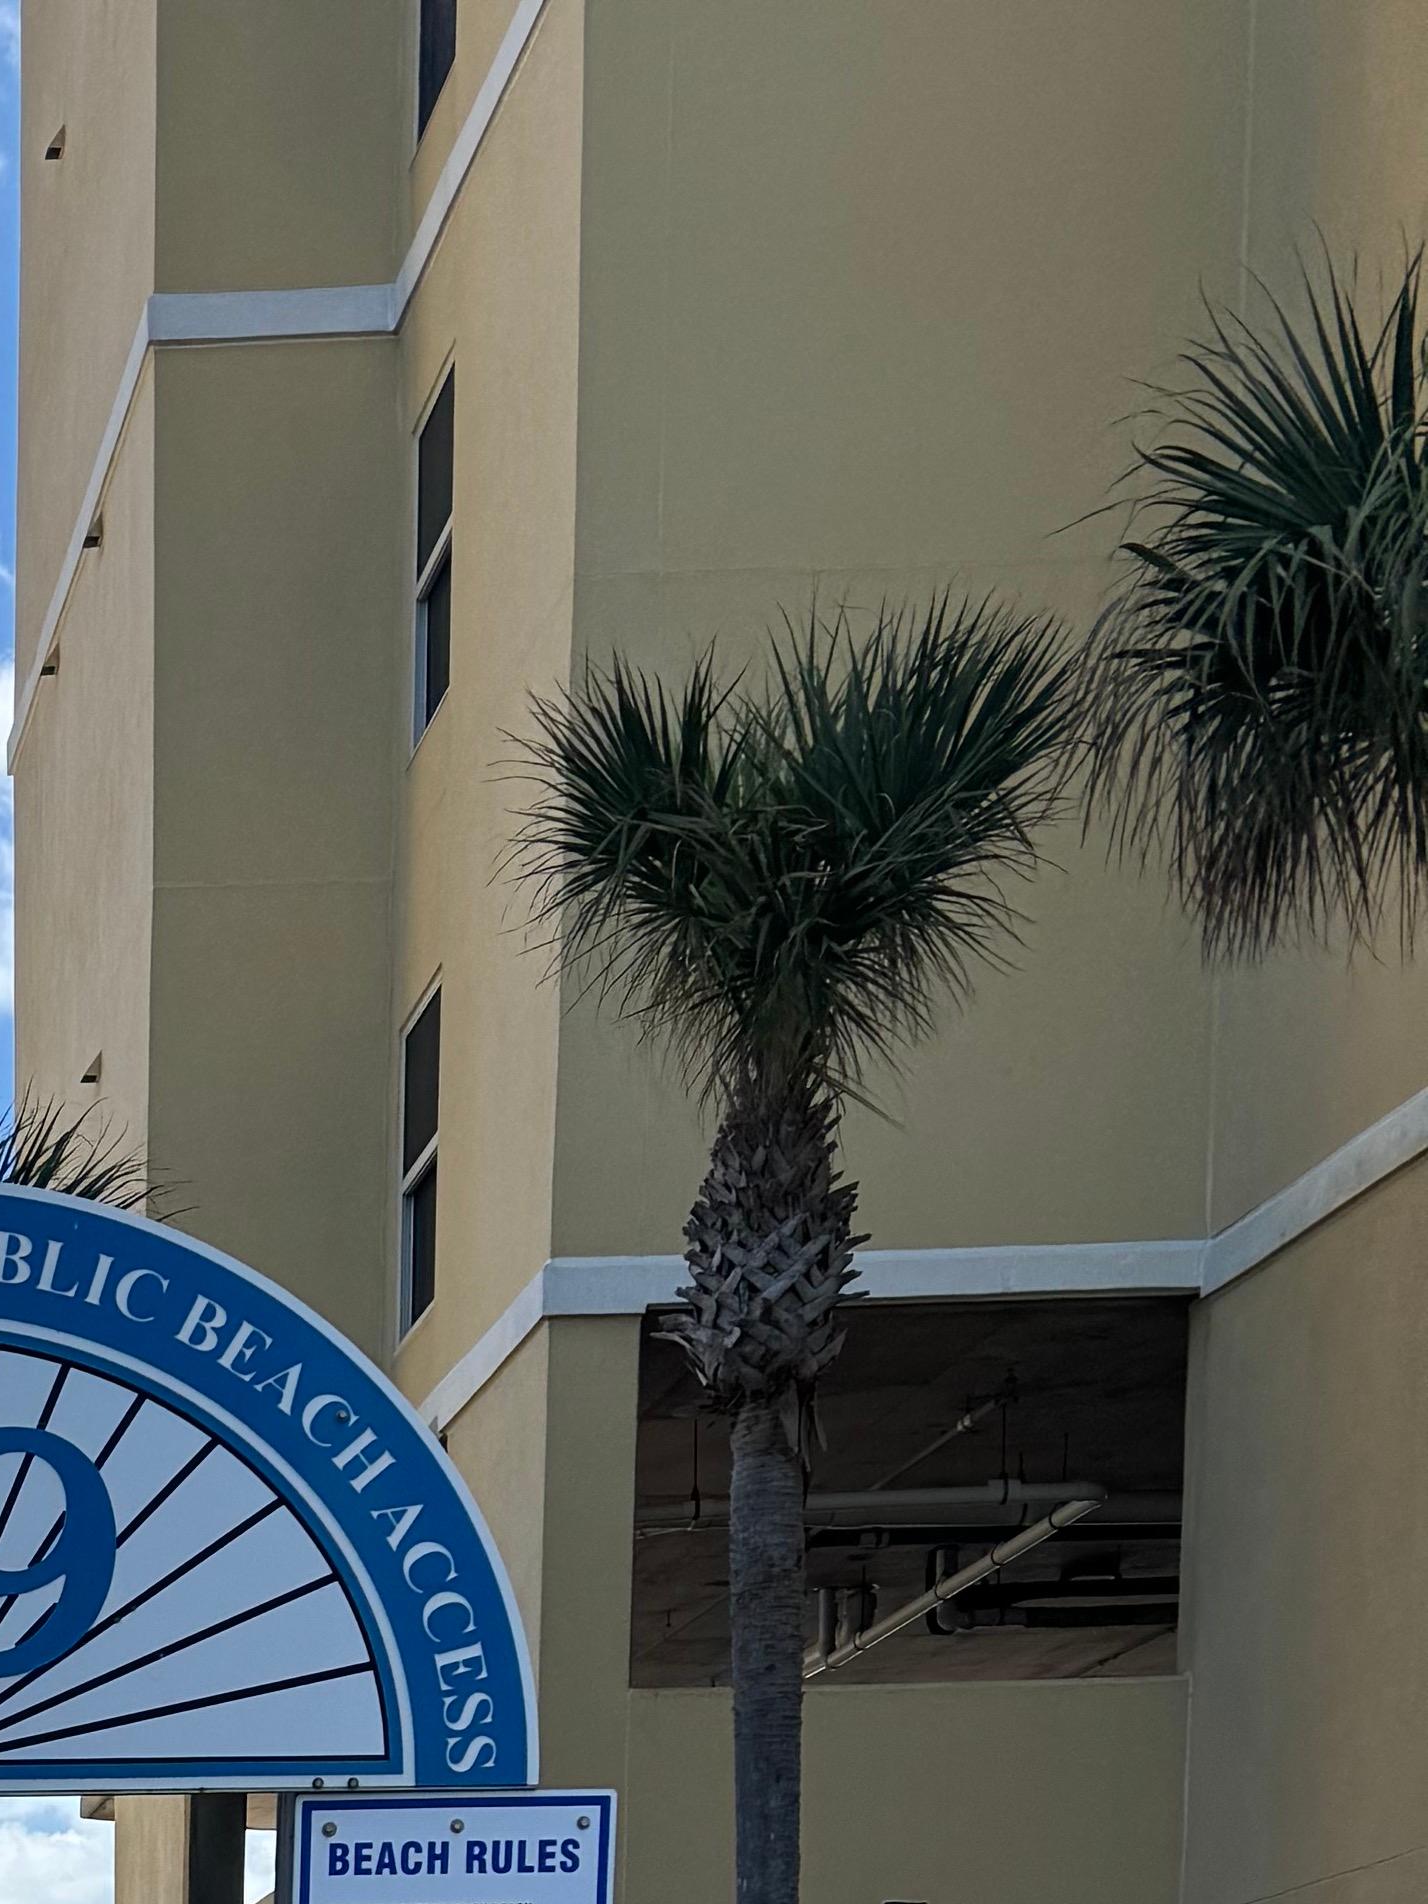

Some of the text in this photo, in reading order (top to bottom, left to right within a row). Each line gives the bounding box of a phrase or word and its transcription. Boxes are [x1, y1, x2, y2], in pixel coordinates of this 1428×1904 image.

[174, 1294, 397, 1494] BEACH
[370, 1504, 497, 1772] ACCESS
[328, 1839, 580, 1876] BEACH RULES
